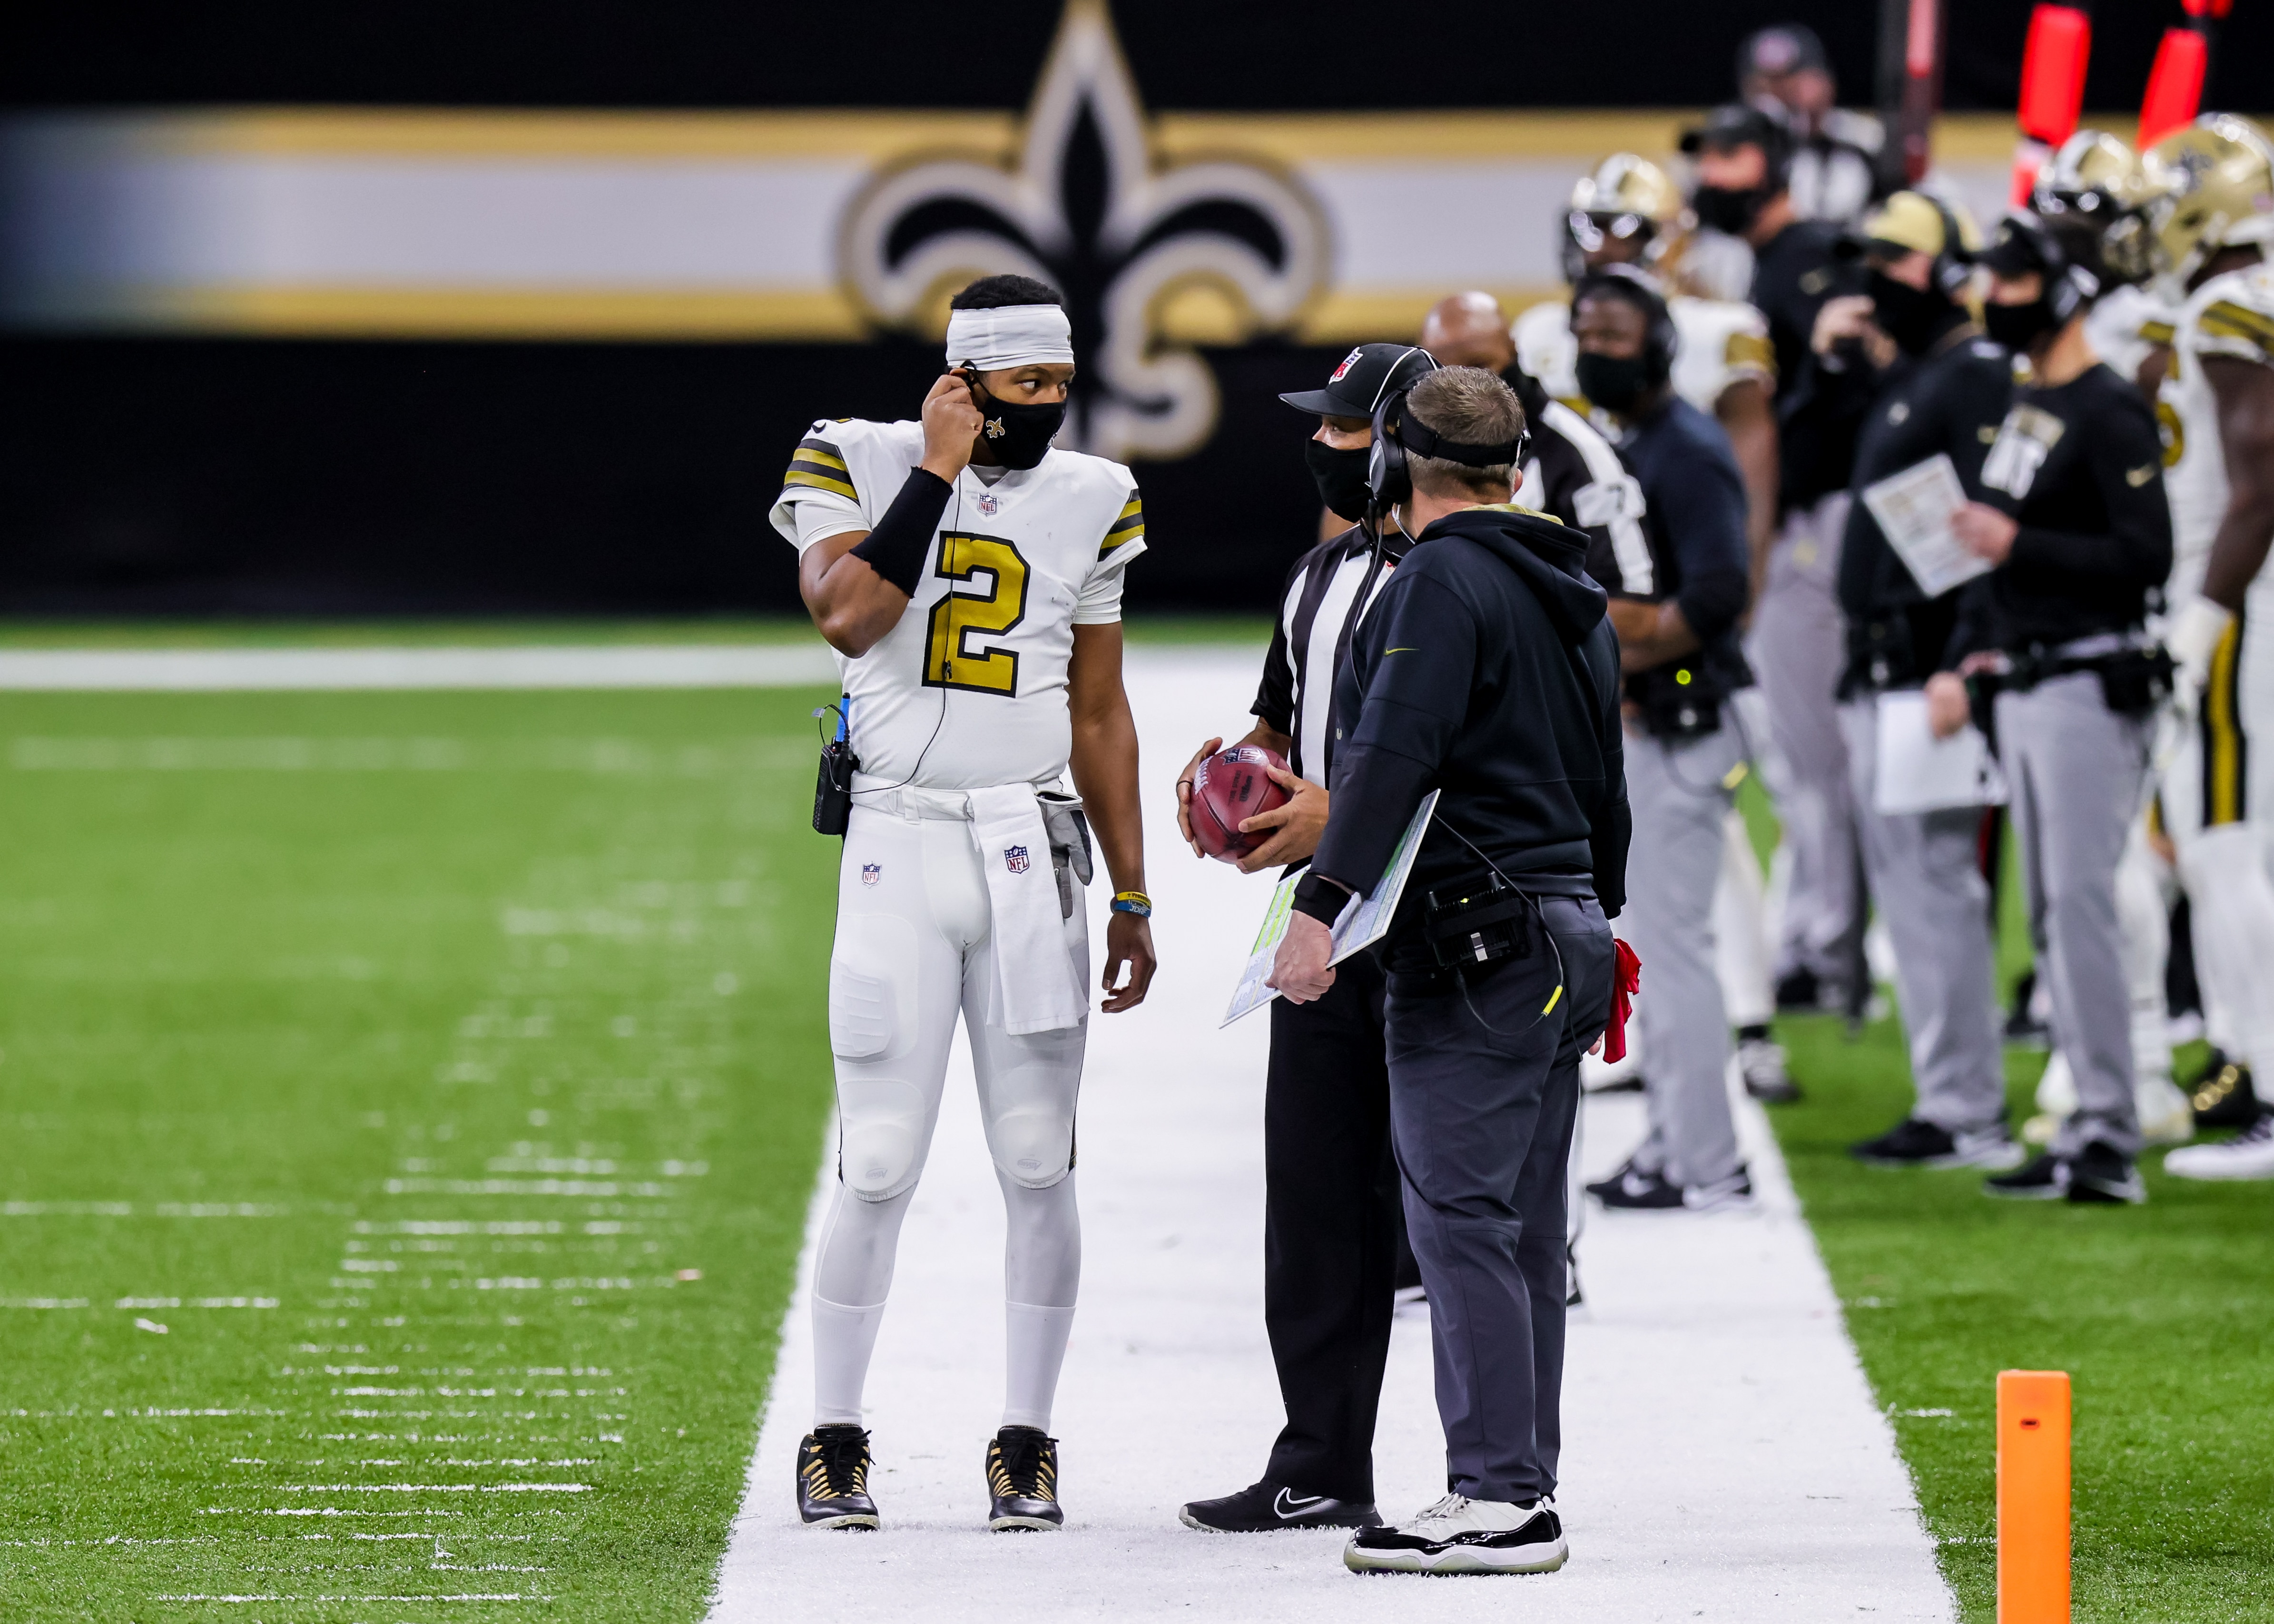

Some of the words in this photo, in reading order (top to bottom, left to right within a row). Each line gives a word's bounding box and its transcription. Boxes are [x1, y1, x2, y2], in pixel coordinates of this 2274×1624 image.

[981, 502, 995, 512] NFL
[922, 531, 1031, 698] 2
[1008, 857, 1028, 871] NFL
[864, 872, 877, 883] NFL
[1129, 905, 1147, 914] JDRF
